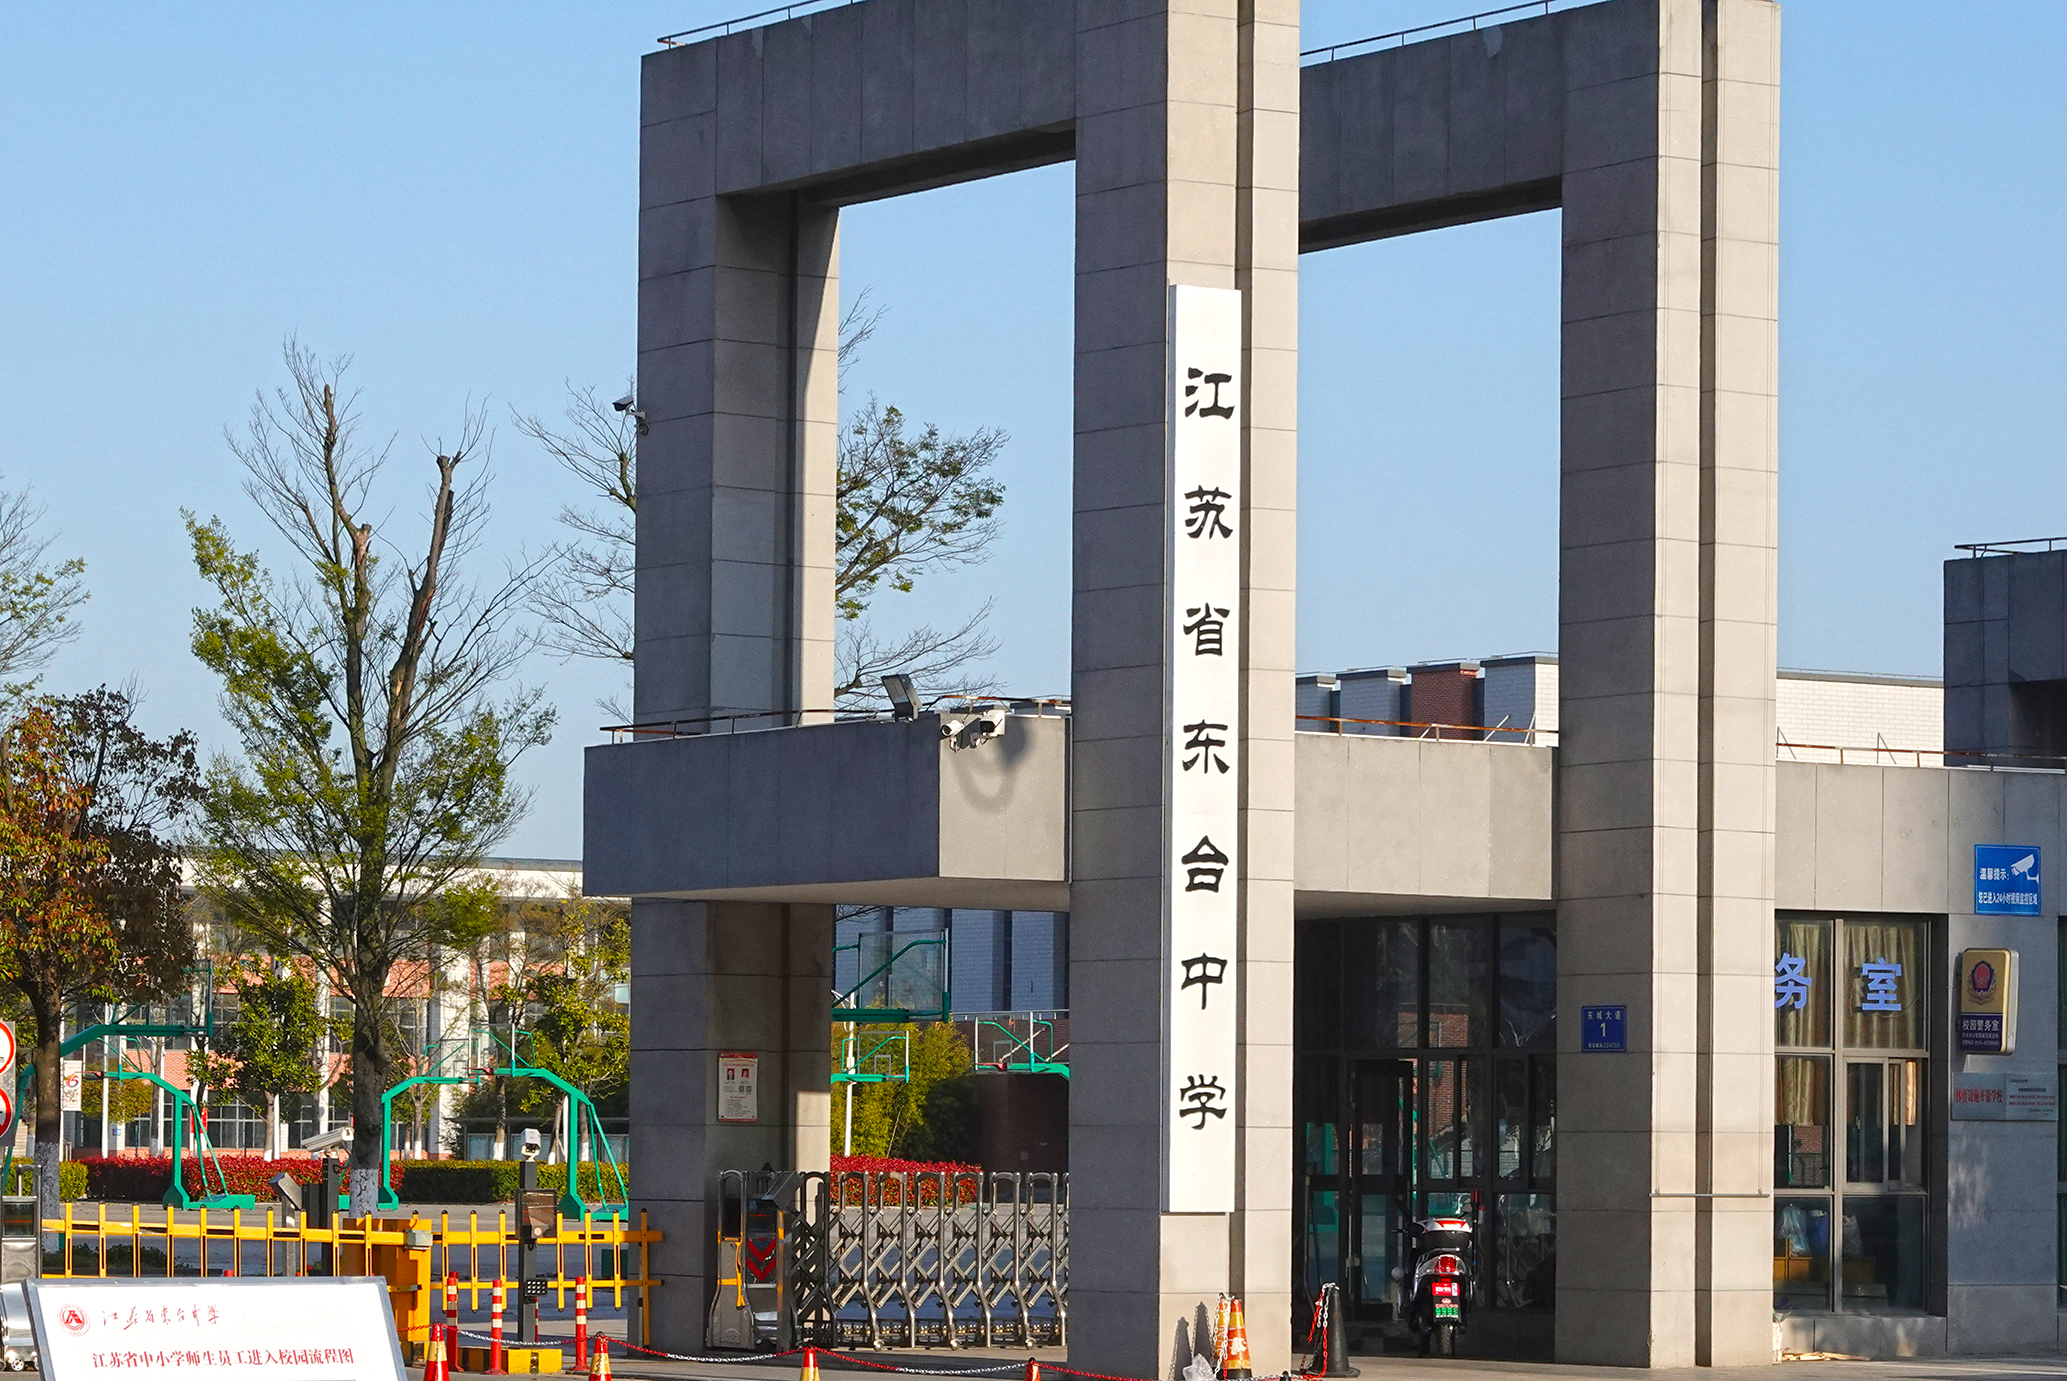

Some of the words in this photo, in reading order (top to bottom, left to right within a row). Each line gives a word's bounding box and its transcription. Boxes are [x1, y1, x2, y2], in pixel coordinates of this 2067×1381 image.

[1179, 367, 1235, 1131] 江苏省东台中学
[1587, 1010, 1621, 1020] 东城大道
[1600, 1022, 1607, 1038] 1
[1962, 1019, 2000, 1032] 校园警务室
[92, 1348, 355, 1368] 江苏省中小学师生员工进入校园流程图
